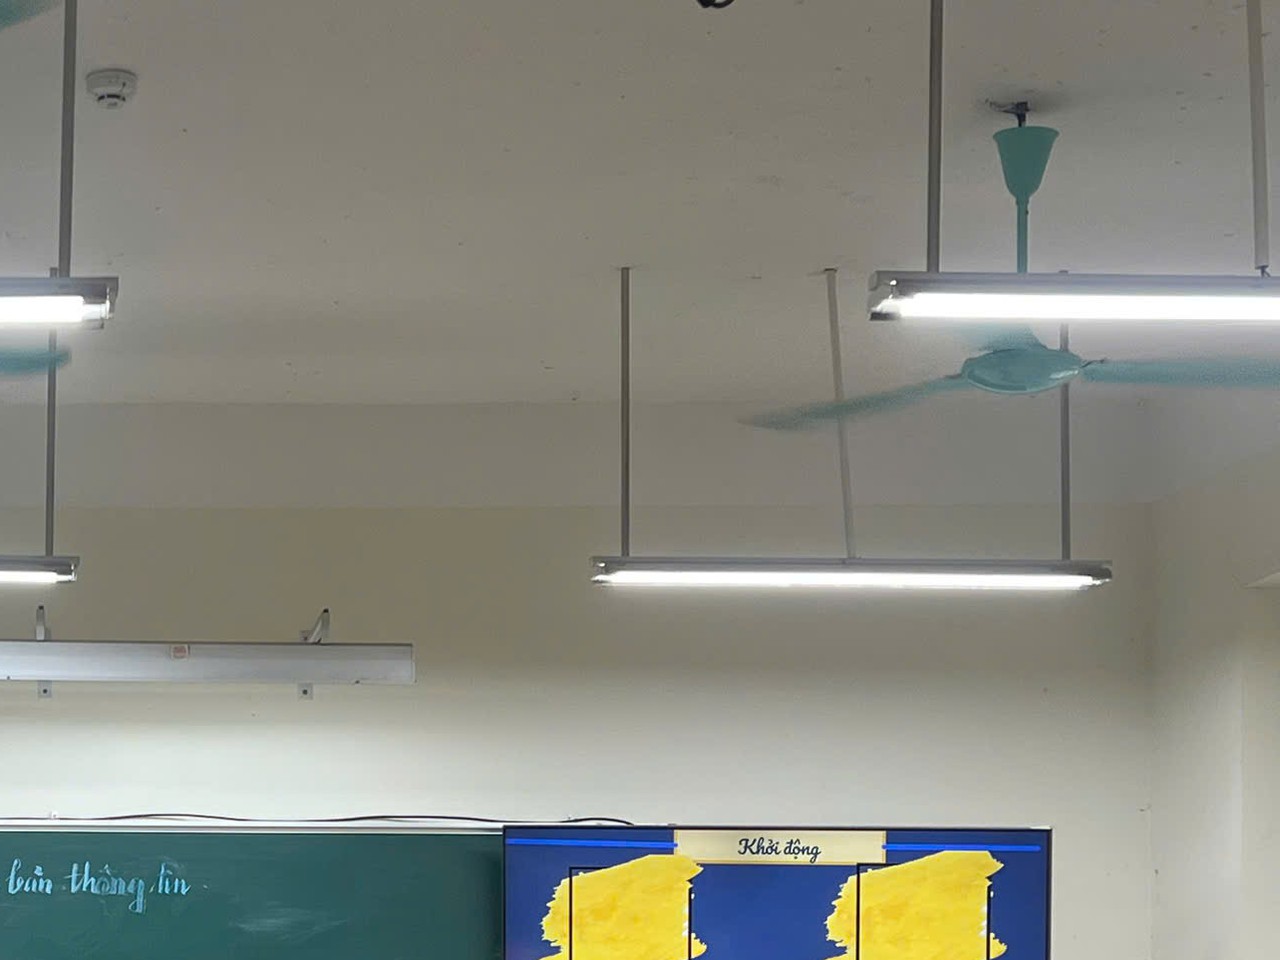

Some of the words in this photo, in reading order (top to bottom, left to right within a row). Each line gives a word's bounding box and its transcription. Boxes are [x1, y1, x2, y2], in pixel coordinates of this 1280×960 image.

[737, 837, 781, 856] Khởi
[783, 838, 822, 864] động
[7, 858, 53, 896] bản
[64, 860, 146, 913] thông
[157, 862, 192, 896] tin
